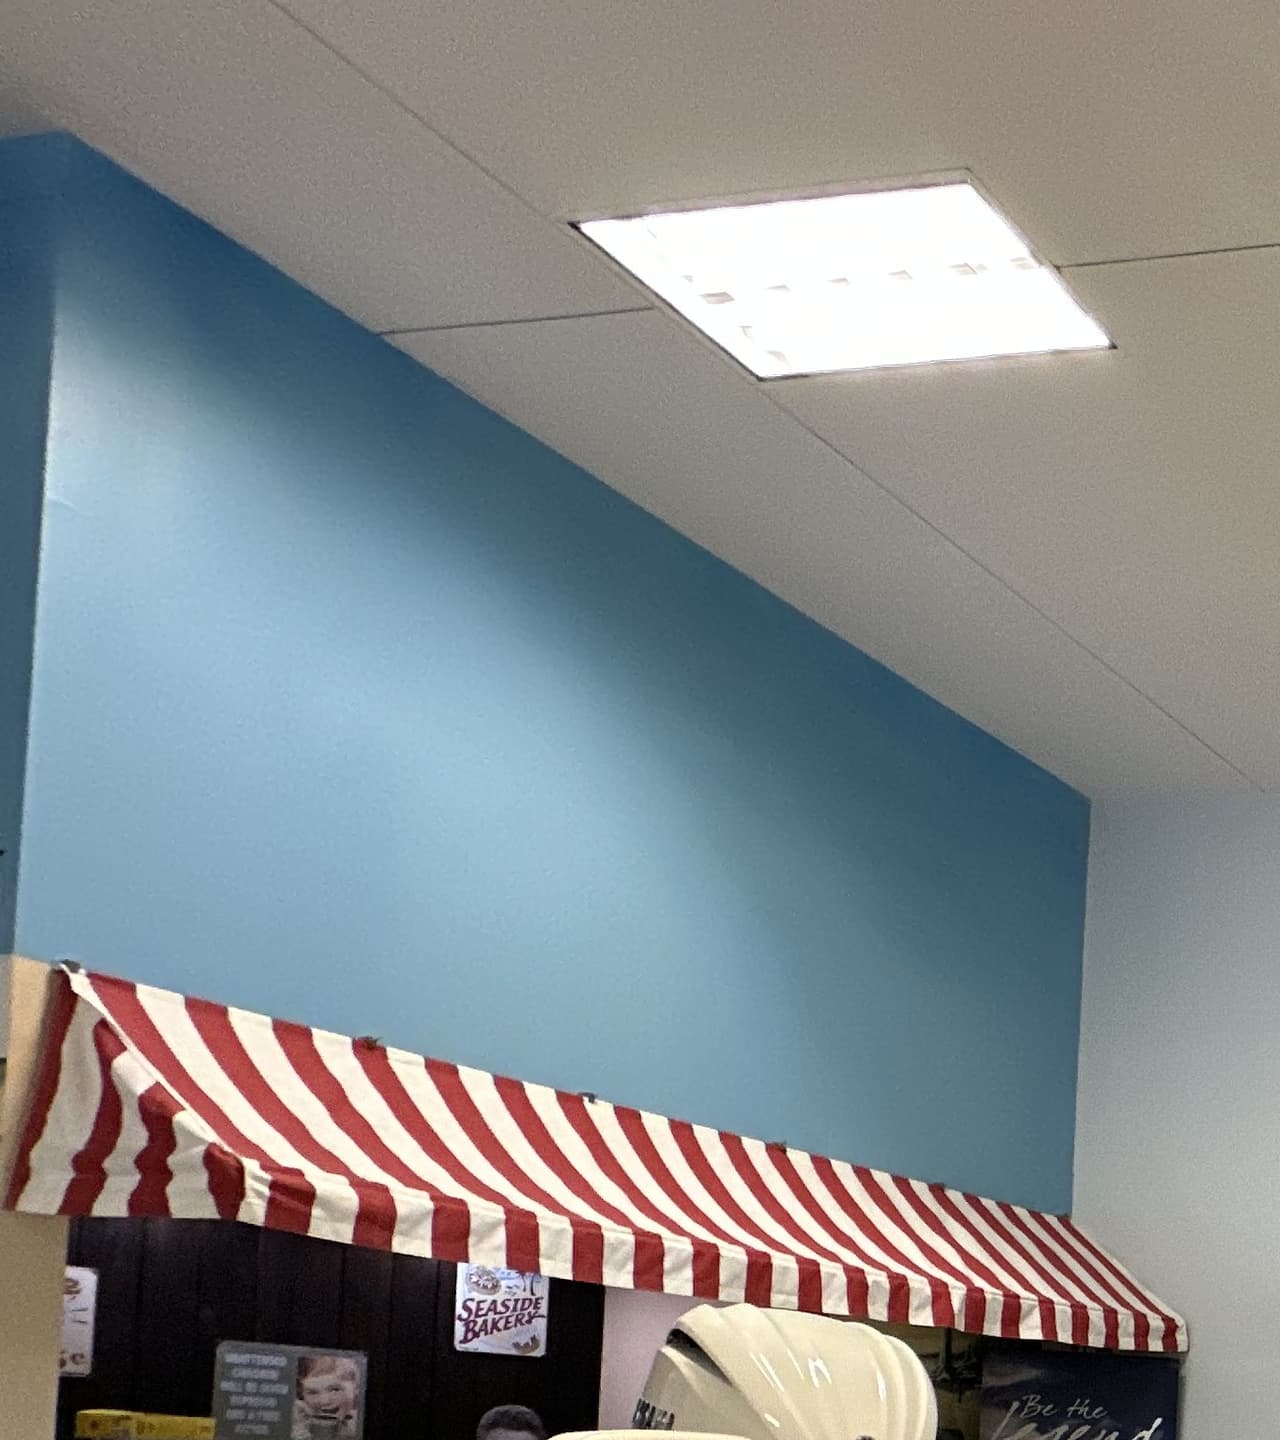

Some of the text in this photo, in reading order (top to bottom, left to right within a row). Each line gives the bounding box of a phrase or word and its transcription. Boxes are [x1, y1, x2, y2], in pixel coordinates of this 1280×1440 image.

[457, 1296, 544, 1322] SEASIDE
[458, 1310, 547, 1345] BAKERY
[1019, 1394, 1108, 1420] Be the
